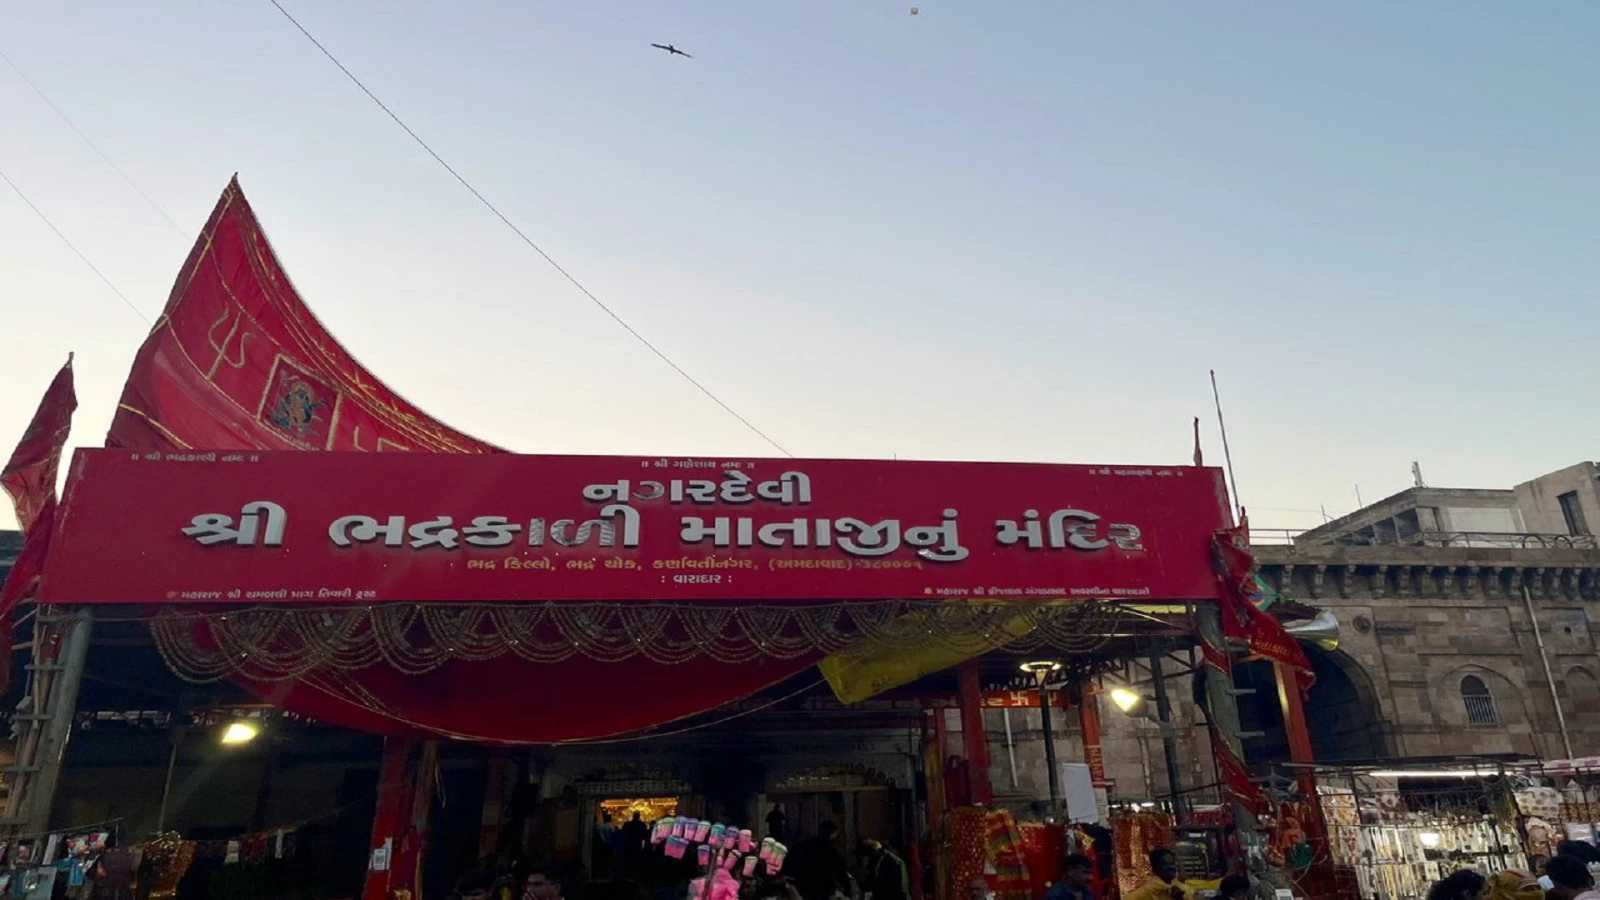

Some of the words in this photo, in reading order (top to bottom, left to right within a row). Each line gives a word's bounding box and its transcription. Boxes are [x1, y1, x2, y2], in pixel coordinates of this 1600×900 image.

[653, 458, 668, 468] શ્રી
[673, 459, 716, 469] ગણેશાય
[582, 470, 812, 503] નગરદેવી
[181, 500, 288, 548] શ્રી
[328, 503, 642, 550] ભદ્રકાળી
[680, 508, 970, 562] માતાજીનું
[995, 508, 1144, 551] મંદિર
[467, 559, 496, 570] ભદ્ર
[504, 557, 556, 571] કિલ્લો,
[566, 559, 595, 570] ભદ્ર
[604, 557, 642, 571] ચોક,
[180, 590, 223, 599] મહારાજ
[227, 588, 241, 599] શ્રી
[318, 588, 352, 598] તિવારી
